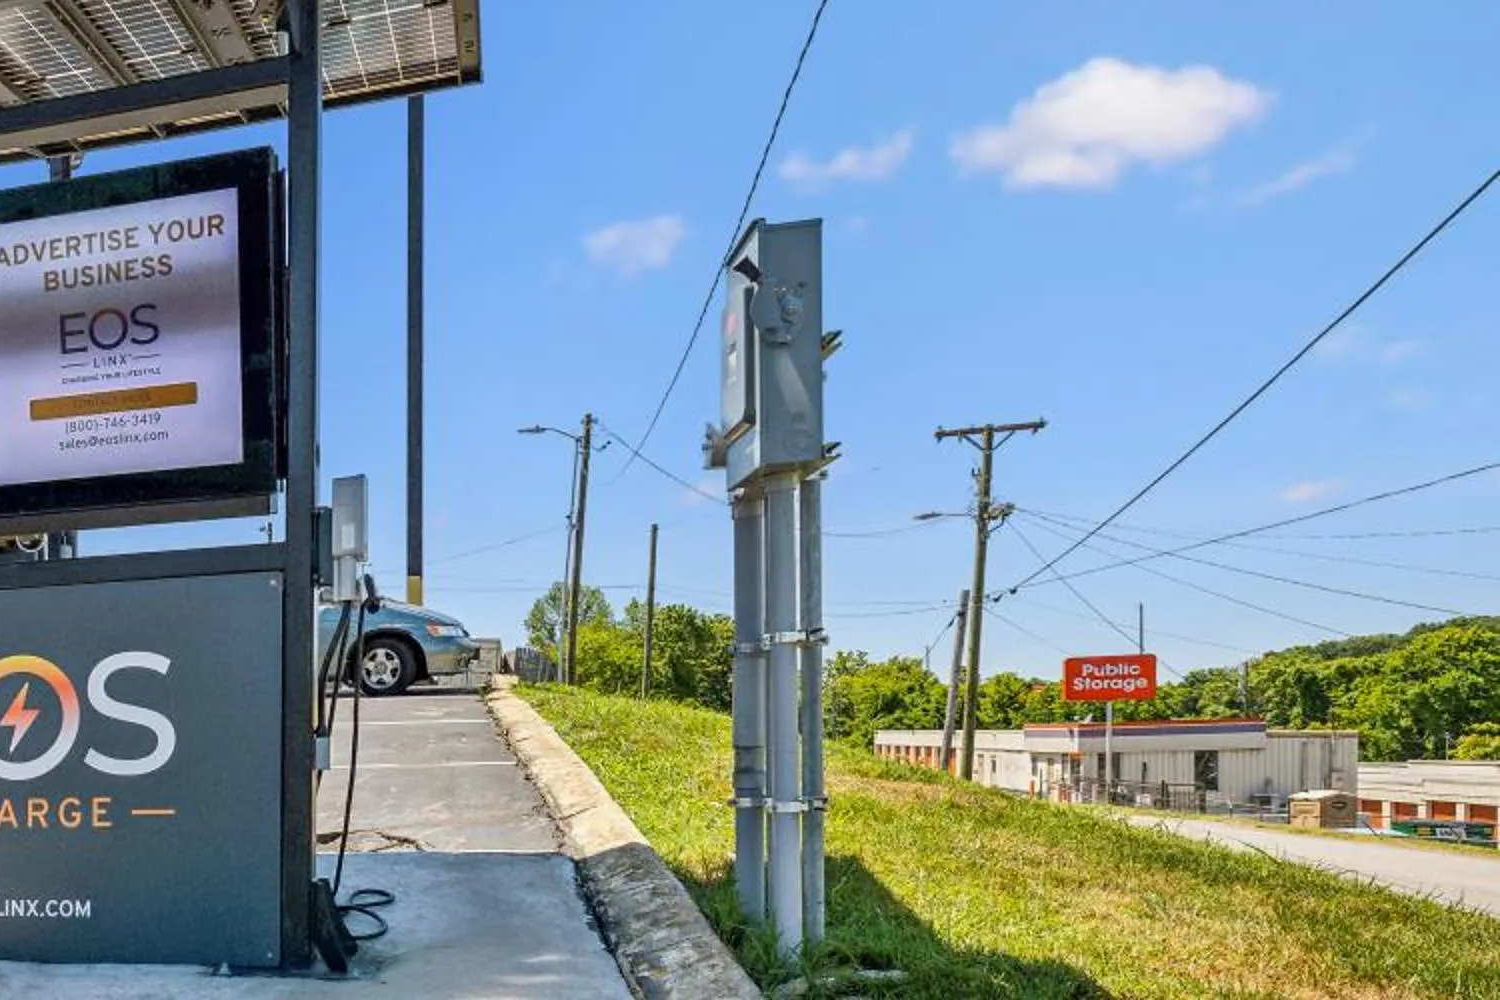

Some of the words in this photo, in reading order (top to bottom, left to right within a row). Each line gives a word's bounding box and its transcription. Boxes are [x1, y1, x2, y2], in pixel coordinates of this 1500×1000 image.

[148, 214, 225, 245] YOUR
[43, 254, 173, 292] BUSINESS
[60, 303, 159, 354] EOS
[65, 413, 161, 434] (800)-746-3419
[59, 431, 169, 451] sales@eoslinx.com
[1082, 664, 1141, 677] Public
[1073, 677, 1149, 692] Storage
